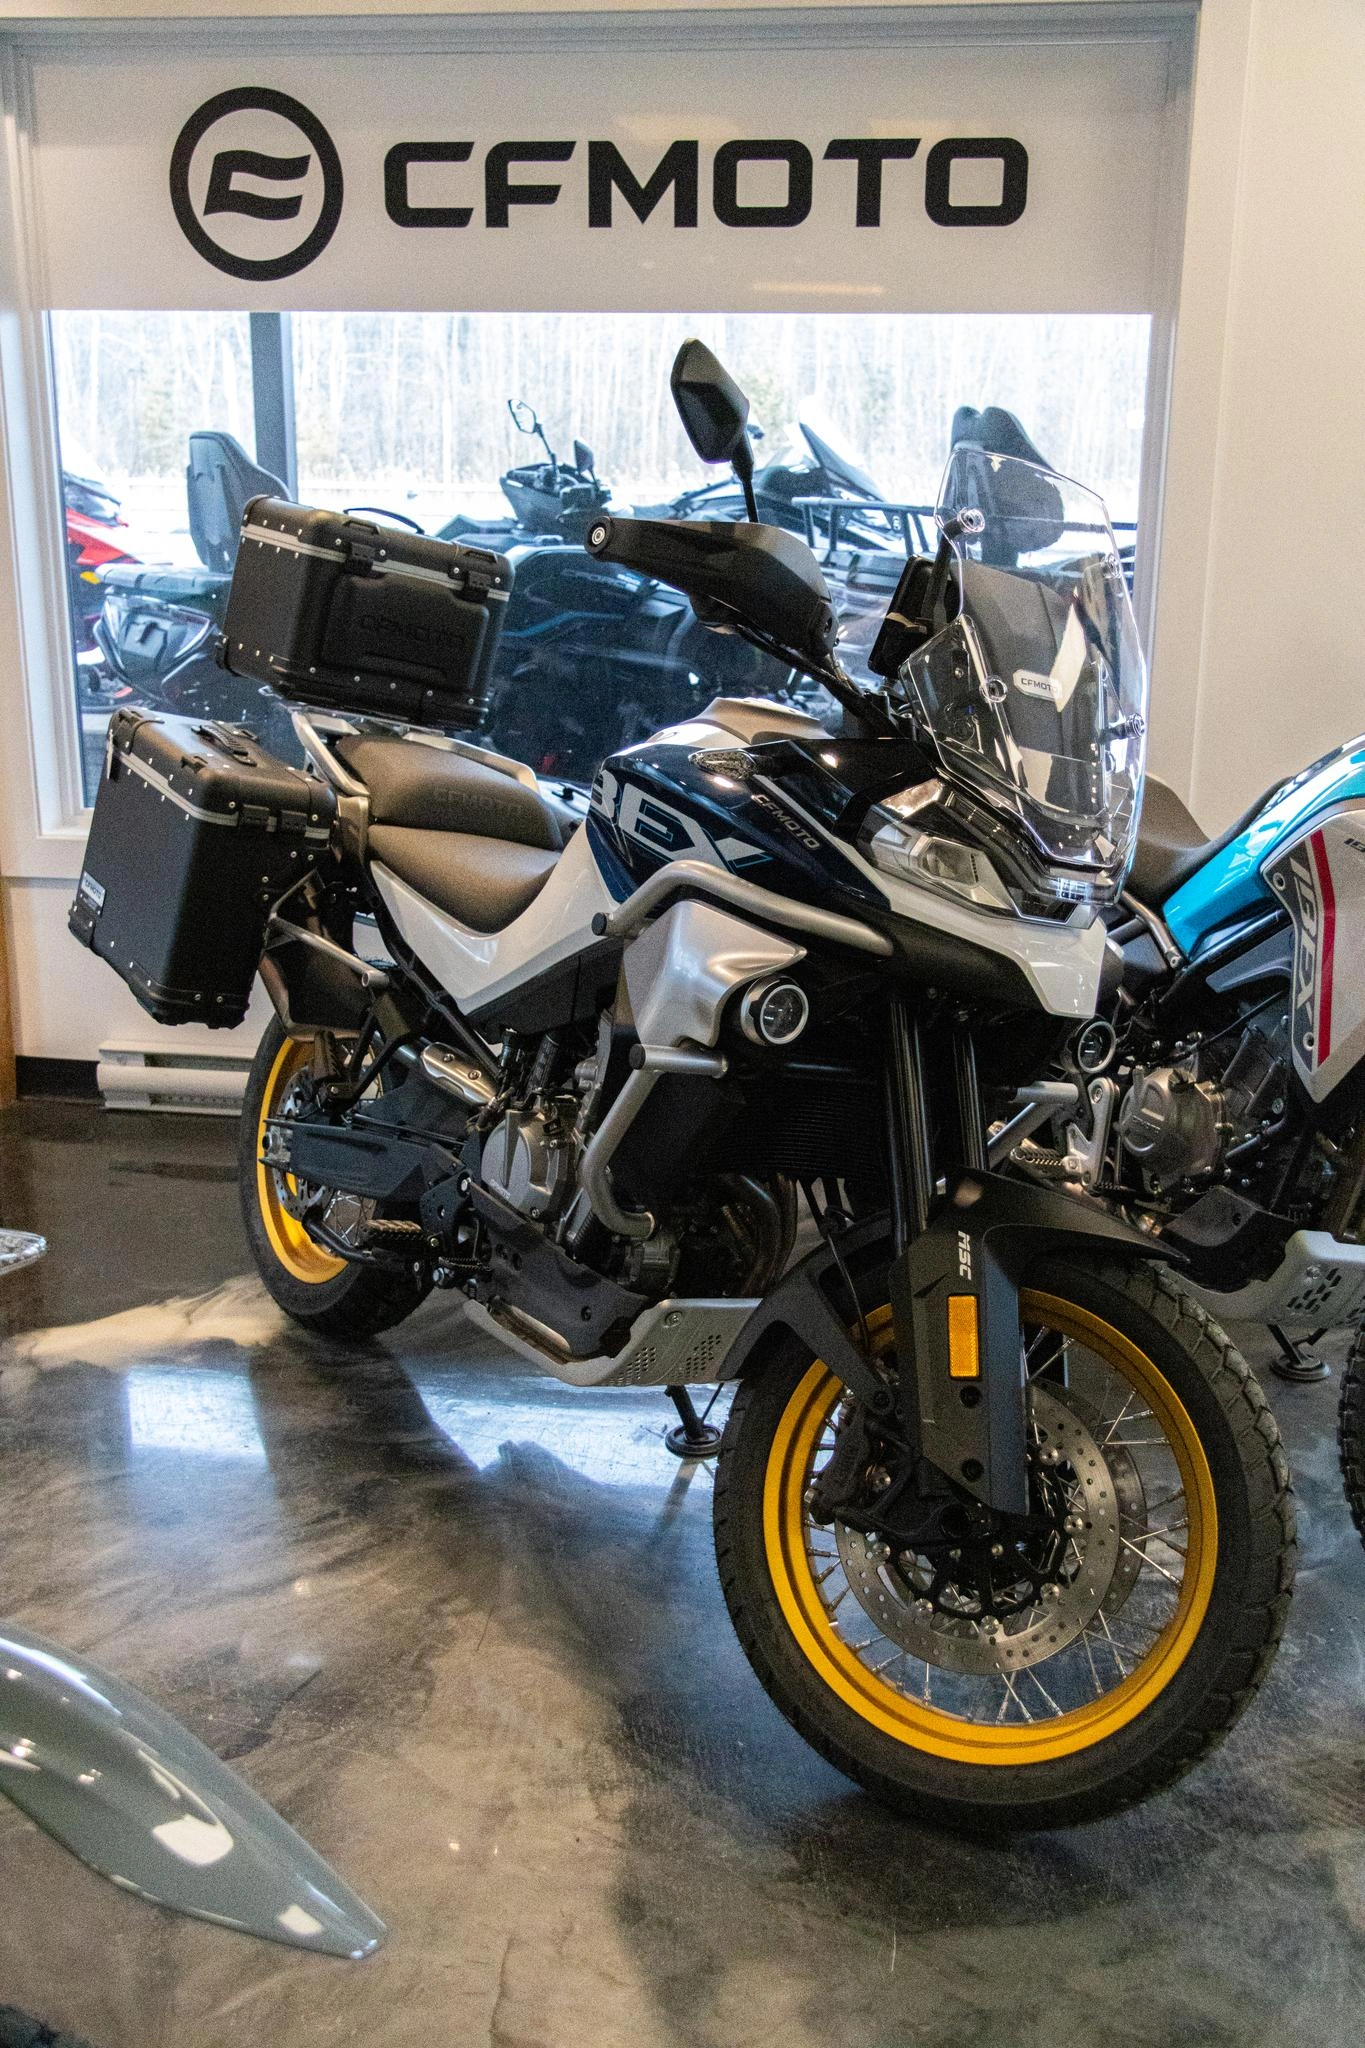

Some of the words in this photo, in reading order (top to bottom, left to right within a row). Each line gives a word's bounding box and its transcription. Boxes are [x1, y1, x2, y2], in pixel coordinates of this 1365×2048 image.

[385, 138, 1028, 227] CFMOTO
[1021, 678, 1053, 692] CFMOT
[753, 794, 820, 849] CFMOTO
[1289, 856, 1318, 1027] IBEX
[958, 1230, 972, 1281] MSC
